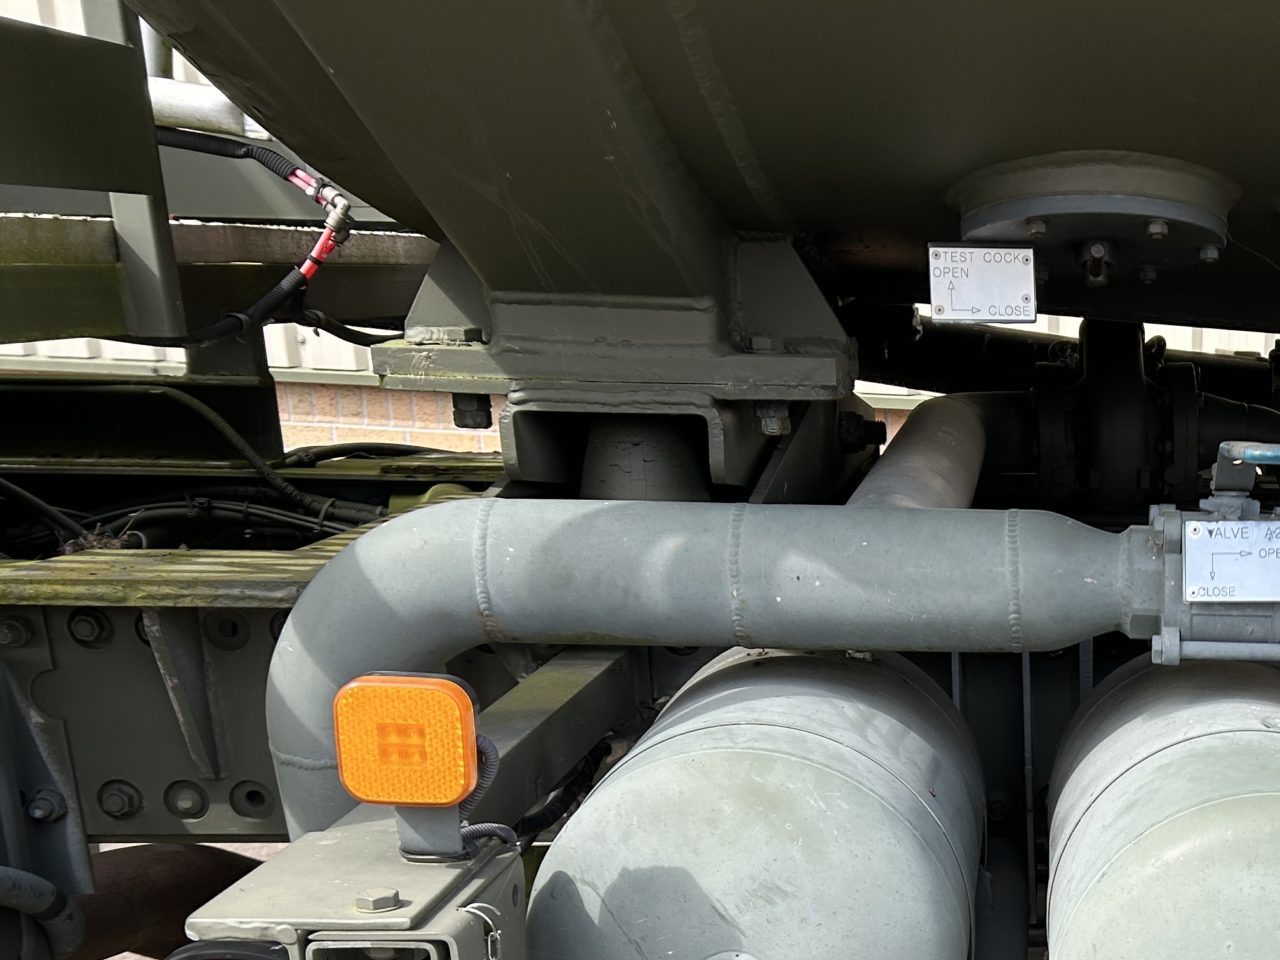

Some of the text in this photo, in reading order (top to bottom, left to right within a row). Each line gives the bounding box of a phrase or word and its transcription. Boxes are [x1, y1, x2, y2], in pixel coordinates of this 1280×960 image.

[942, 251, 1022, 263] TEST COCK
[933, 267, 969, 278] OPEN
[988, 305, 1031, 316] CLOSE
[1207, 527, 1249, 539] VALVE
[1197, 586, 1236, 597] CLOSE
